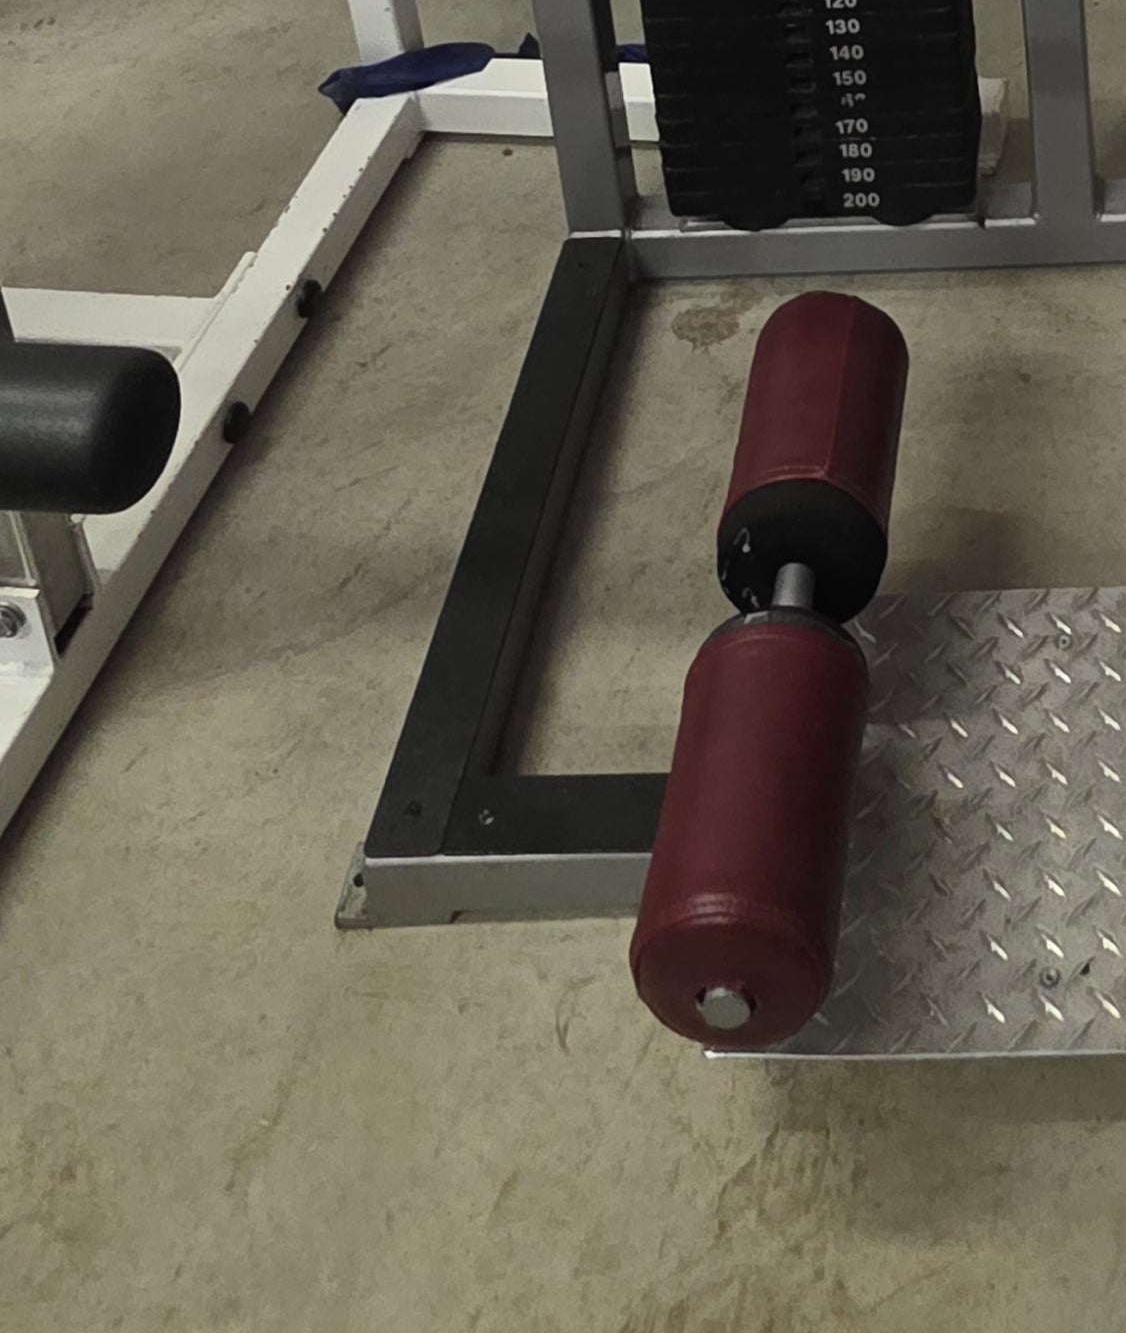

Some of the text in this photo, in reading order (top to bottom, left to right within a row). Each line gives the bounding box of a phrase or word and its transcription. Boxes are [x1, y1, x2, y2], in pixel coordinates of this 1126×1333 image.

[825, 18, 860, 35] 130
[830, 44, 864, 60] 140
[833, 70, 867, 85] 150
[835, 118, 868, 134] 170
[839, 142, 873, 158] 180
[842, 167, 875, 182] 190
[843, 192, 880, 208] 200
